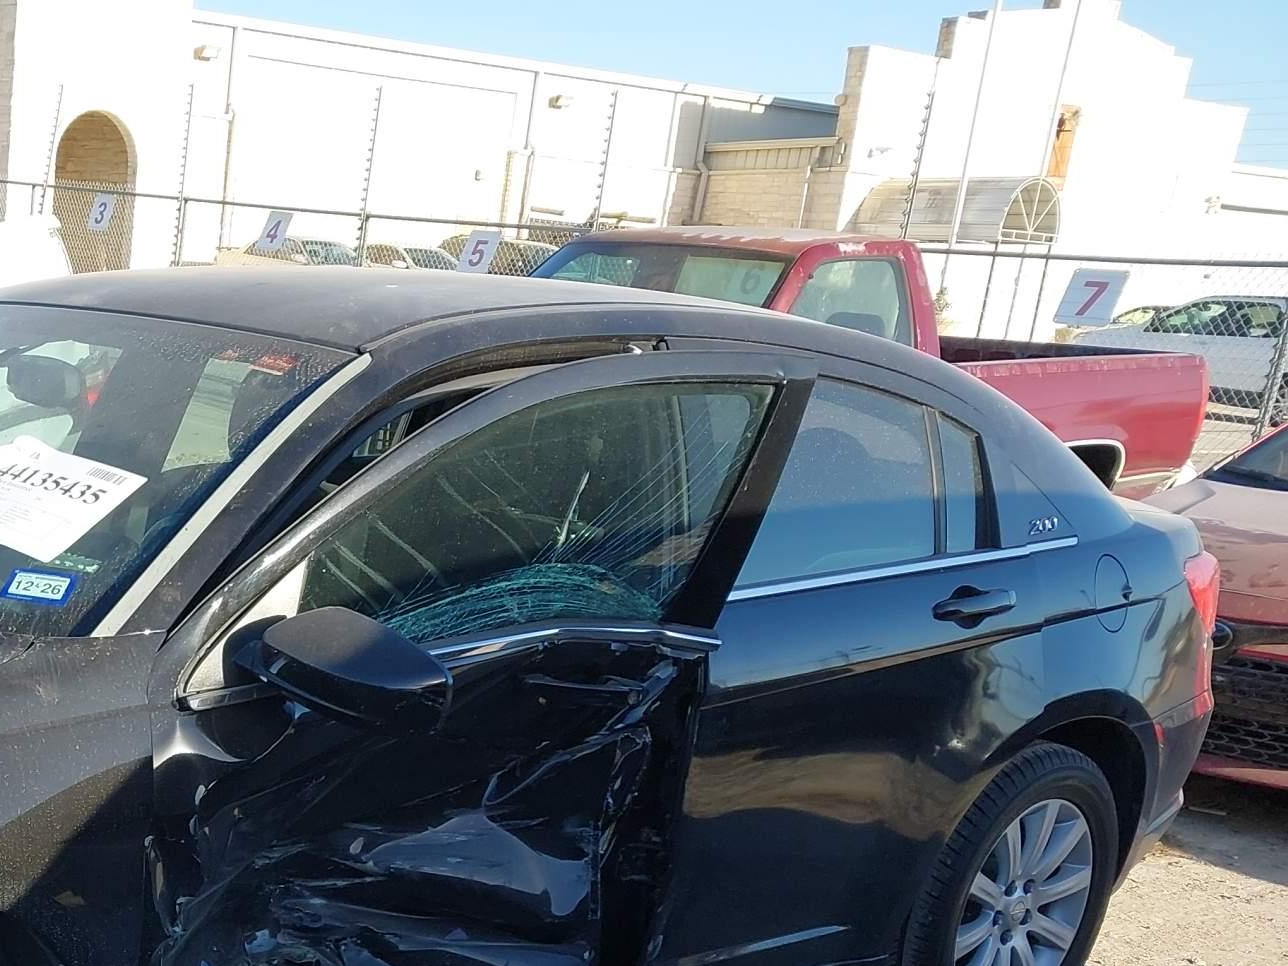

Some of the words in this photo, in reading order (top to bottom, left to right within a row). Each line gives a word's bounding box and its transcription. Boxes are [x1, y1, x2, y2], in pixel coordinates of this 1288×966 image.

[94, 201, 108, 225] 3
[265, 219, 282, 244] 4
[467, 239, 489, 267] 5
[1074, 280, 1110, 316] 7
[1028, 516, 1058, 536] 200
[15, 580, 35, 592] 12
[40, 582, 63, 596] 26
